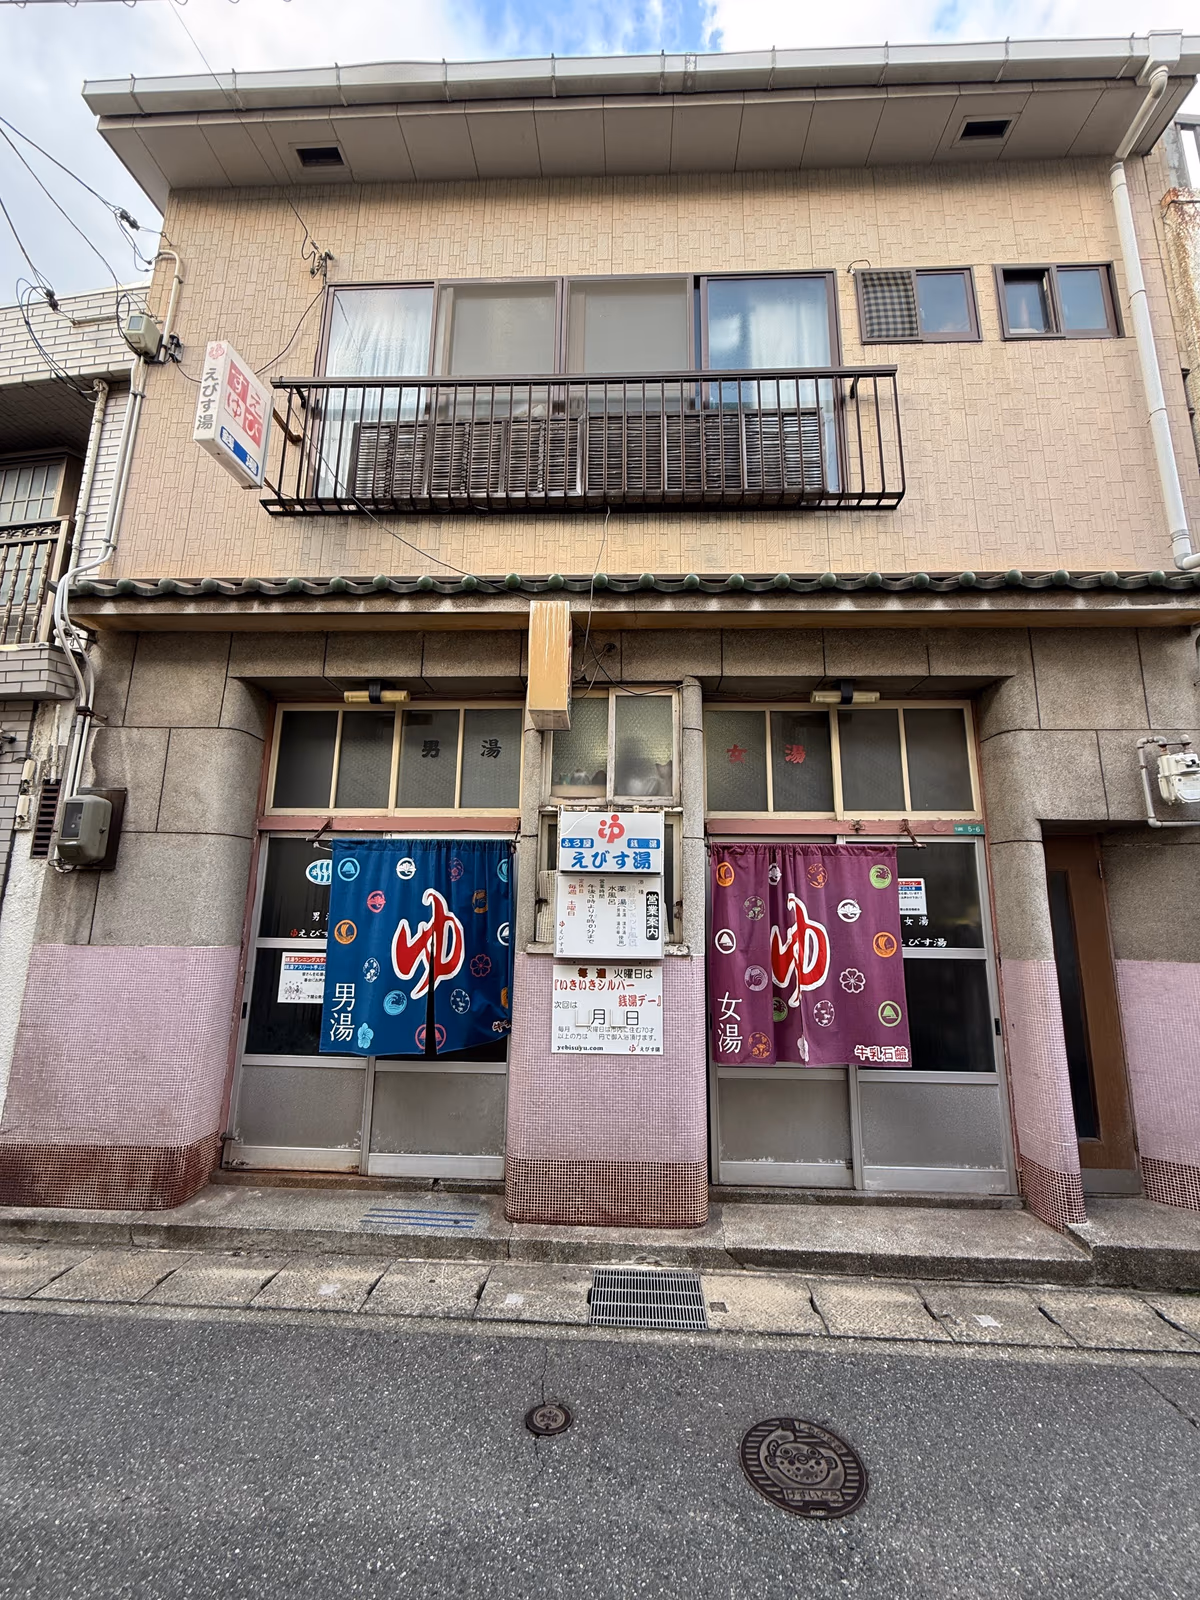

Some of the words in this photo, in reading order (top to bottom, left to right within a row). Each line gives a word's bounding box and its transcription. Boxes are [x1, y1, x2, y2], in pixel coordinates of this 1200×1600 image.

[197, 368, 219, 430] えびす湯
[597, 813, 626, 844] ゆ
[562, 839, 592, 848] ふろ屋
[630, 839, 658, 848] 銭湯
[571, 850, 651, 870] えびす湯
[607, 885, 617, 906] 水風呂
[646, 893, 659, 938] 営業案内
[904, 916, 929, 926] 女湯
[391, 888, 466, 1000] ゆ
[770, 893, 831, 1008] ゆ
[614, 968, 654, 979] 火曜日は
[329, 982, 356, 1042] 男湯
[554, 1001, 578, 1009] 次回は
[590, 1008, 606, 1026] 月
[625, 1010, 639, 1026] 日
[717, 991, 743, 1054] 女湯
[556, 1044, 604, 1052] yebisuyu.com
